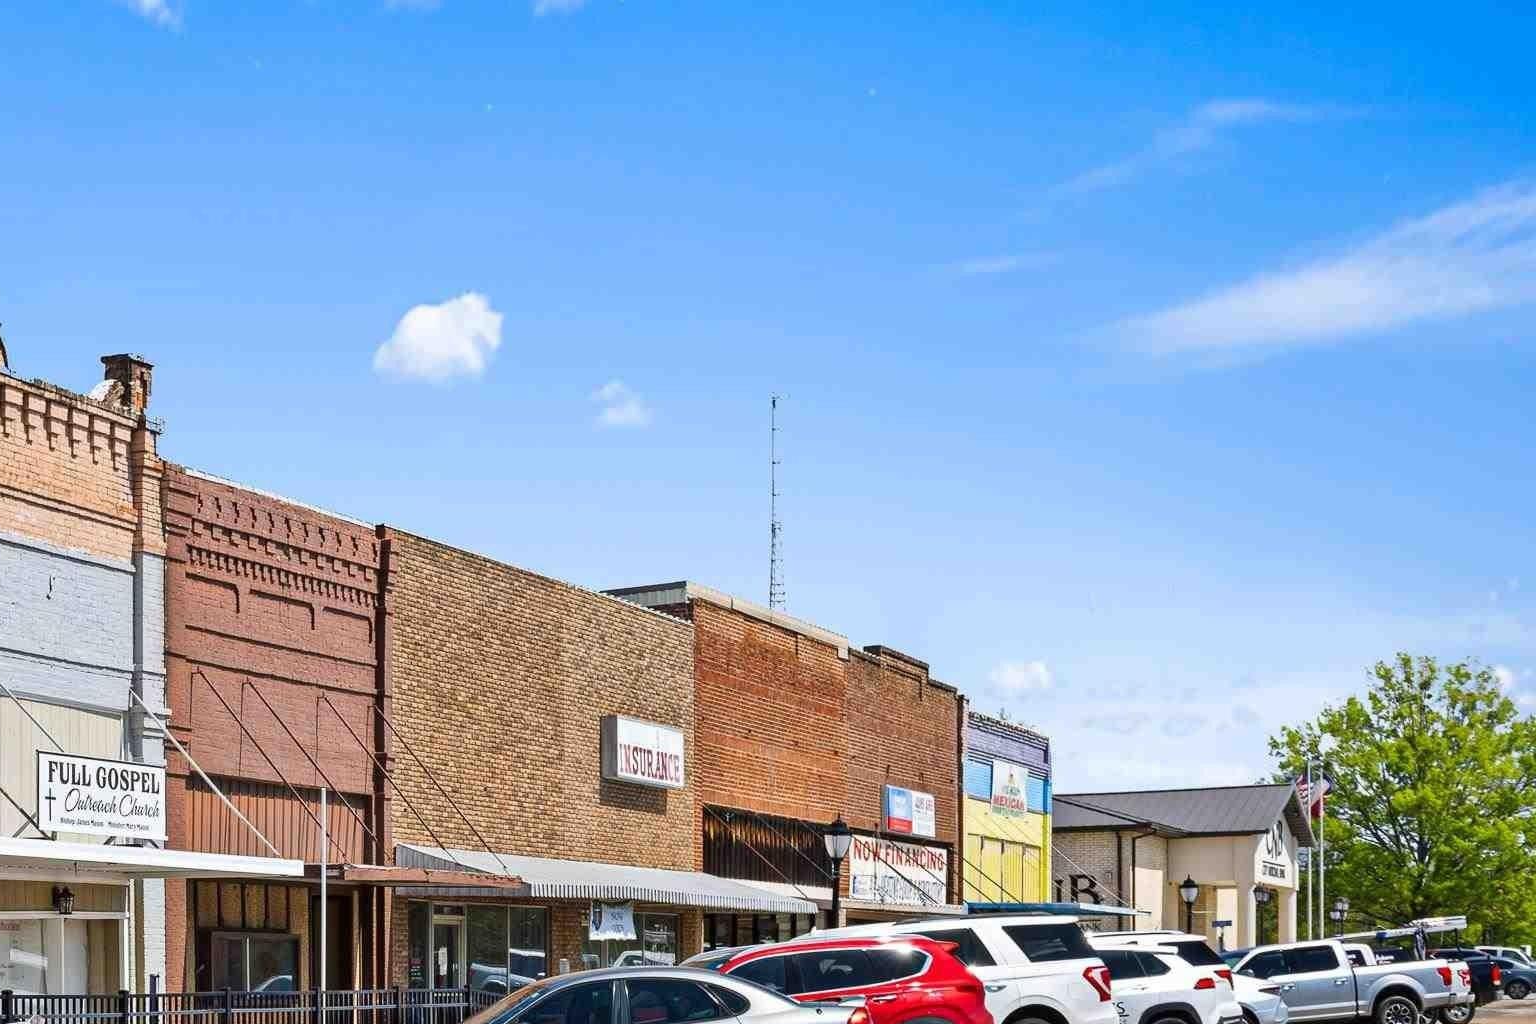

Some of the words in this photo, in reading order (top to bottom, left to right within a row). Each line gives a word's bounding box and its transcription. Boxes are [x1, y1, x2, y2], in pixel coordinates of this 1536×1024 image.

[48, 760, 91, 787] FULL
[96, 766, 160, 794] GOSPEL
[619, 743, 681, 783] INSURANCE
[64, 788, 117, 814] Outreach
[119, 793, 160, 818] Church
[854, 841, 881, 862] NOW
[885, 844, 944, 871] FINANCING
